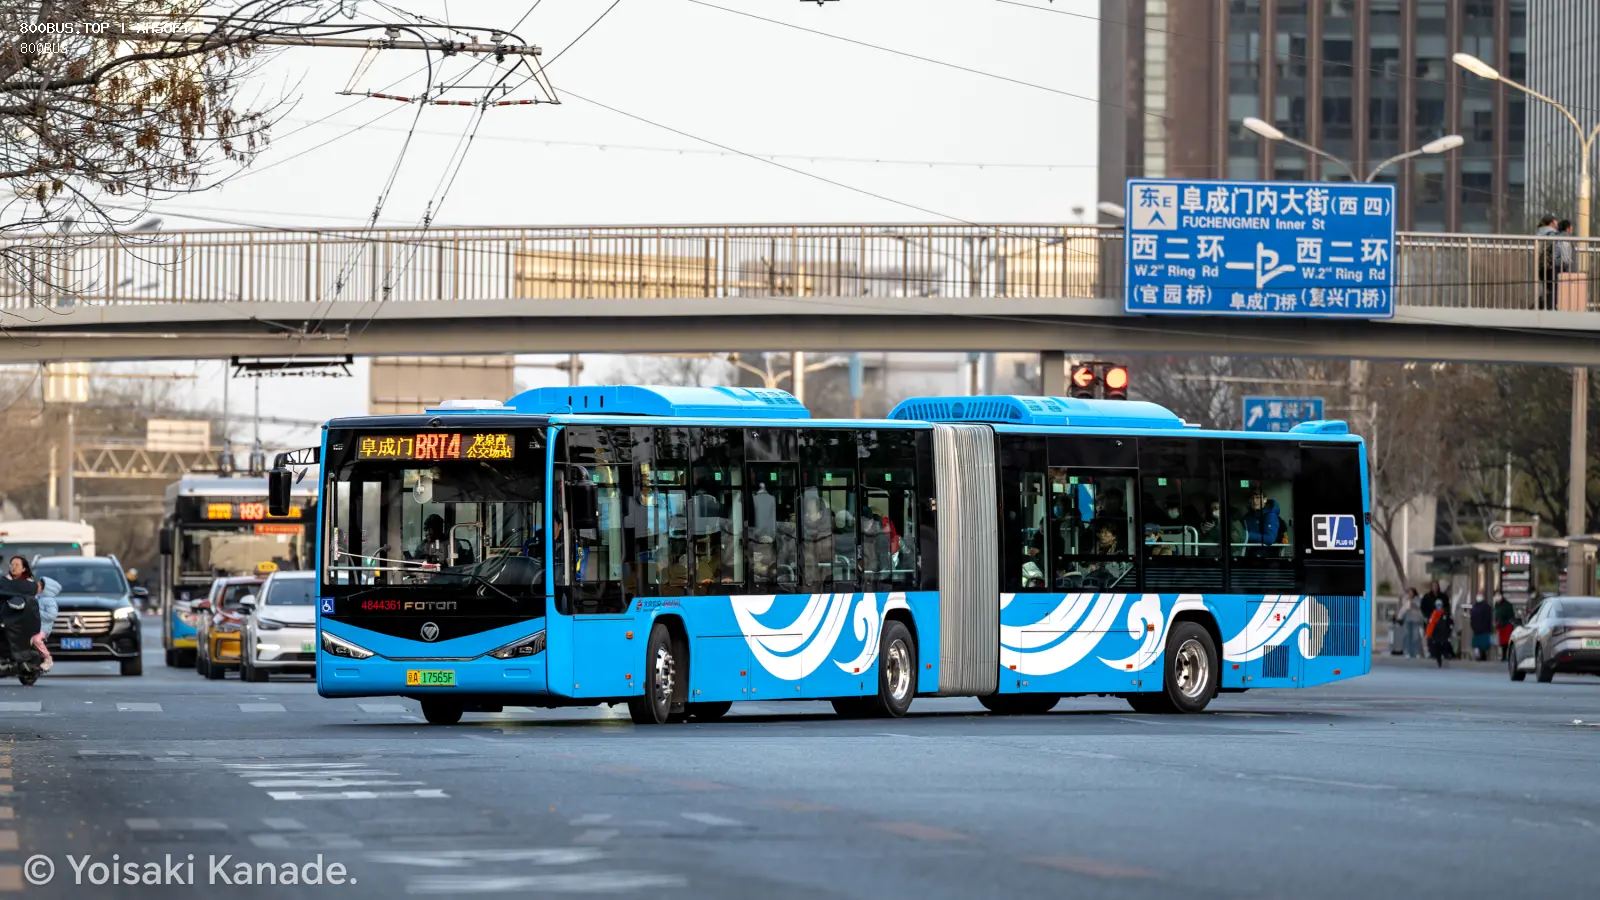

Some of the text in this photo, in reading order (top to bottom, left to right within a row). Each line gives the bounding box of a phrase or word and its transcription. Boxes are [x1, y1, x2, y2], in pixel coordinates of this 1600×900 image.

[1182, 215, 1326, 231] FUCHENGMEN Inner St
[1131, 234, 1225, 263] 西二环
[1296, 237, 1389, 266] 西二环
[1167, 264, 1196, 280] Ring
[1202, 265, 1219, 277] Rd
[1335, 267, 1363, 283] Ring
[1368, 268, 1386, 281] Rd
[1229, 292, 1298, 312] 阜成门桥
[360, 433, 461, 459] 阜成门 BRT4
[473, 433, 508, 447] 龙泉西
[361, 600, 457, 611] 4844361 FOTON
